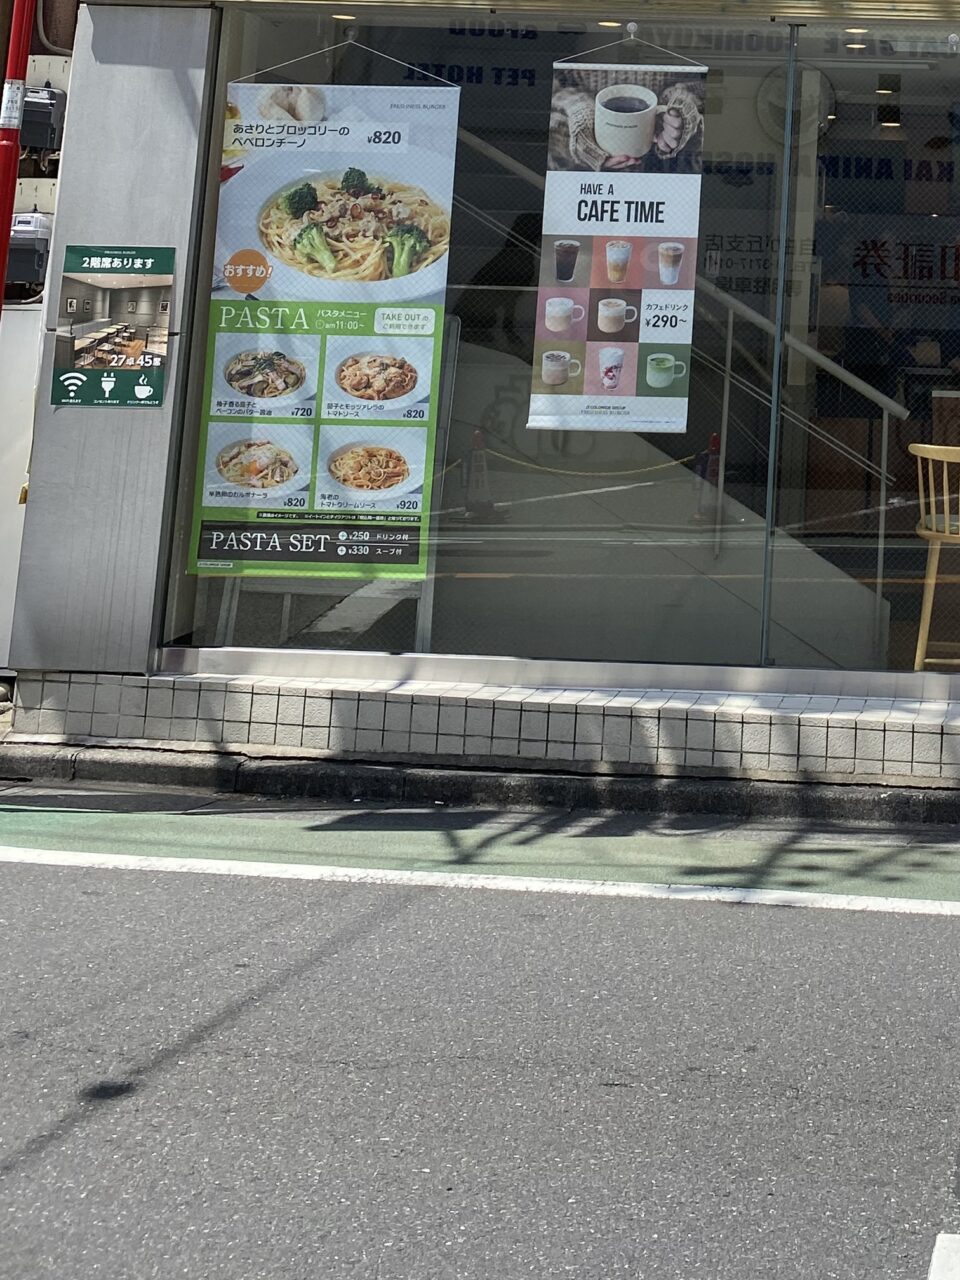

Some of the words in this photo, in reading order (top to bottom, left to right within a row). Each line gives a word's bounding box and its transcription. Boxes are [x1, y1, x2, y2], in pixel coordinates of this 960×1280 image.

[232, 123, 350, 136] あさりとブロッコリーの
[366, 130, 402, 145] ¥820
[580, 183, 603, 195] HAVE
[607, 184, 614, 195] A
[577, 199, 621, 222] CAFE
[624, 200, 666, 224] TIME
[81, 257, 155, 270] 2階席あります
[644, 302, 689, 312] カフェドリンク
[218, 305, 310, 330] PASTA
[316, 310, 367, 319] パスタメニュー
[381, 312, 403, 320] TAKE
[404, 313, 421, 321] OUT
[209, 531, 282, 552] PASTA
[288, 534, 331, 553] SET
